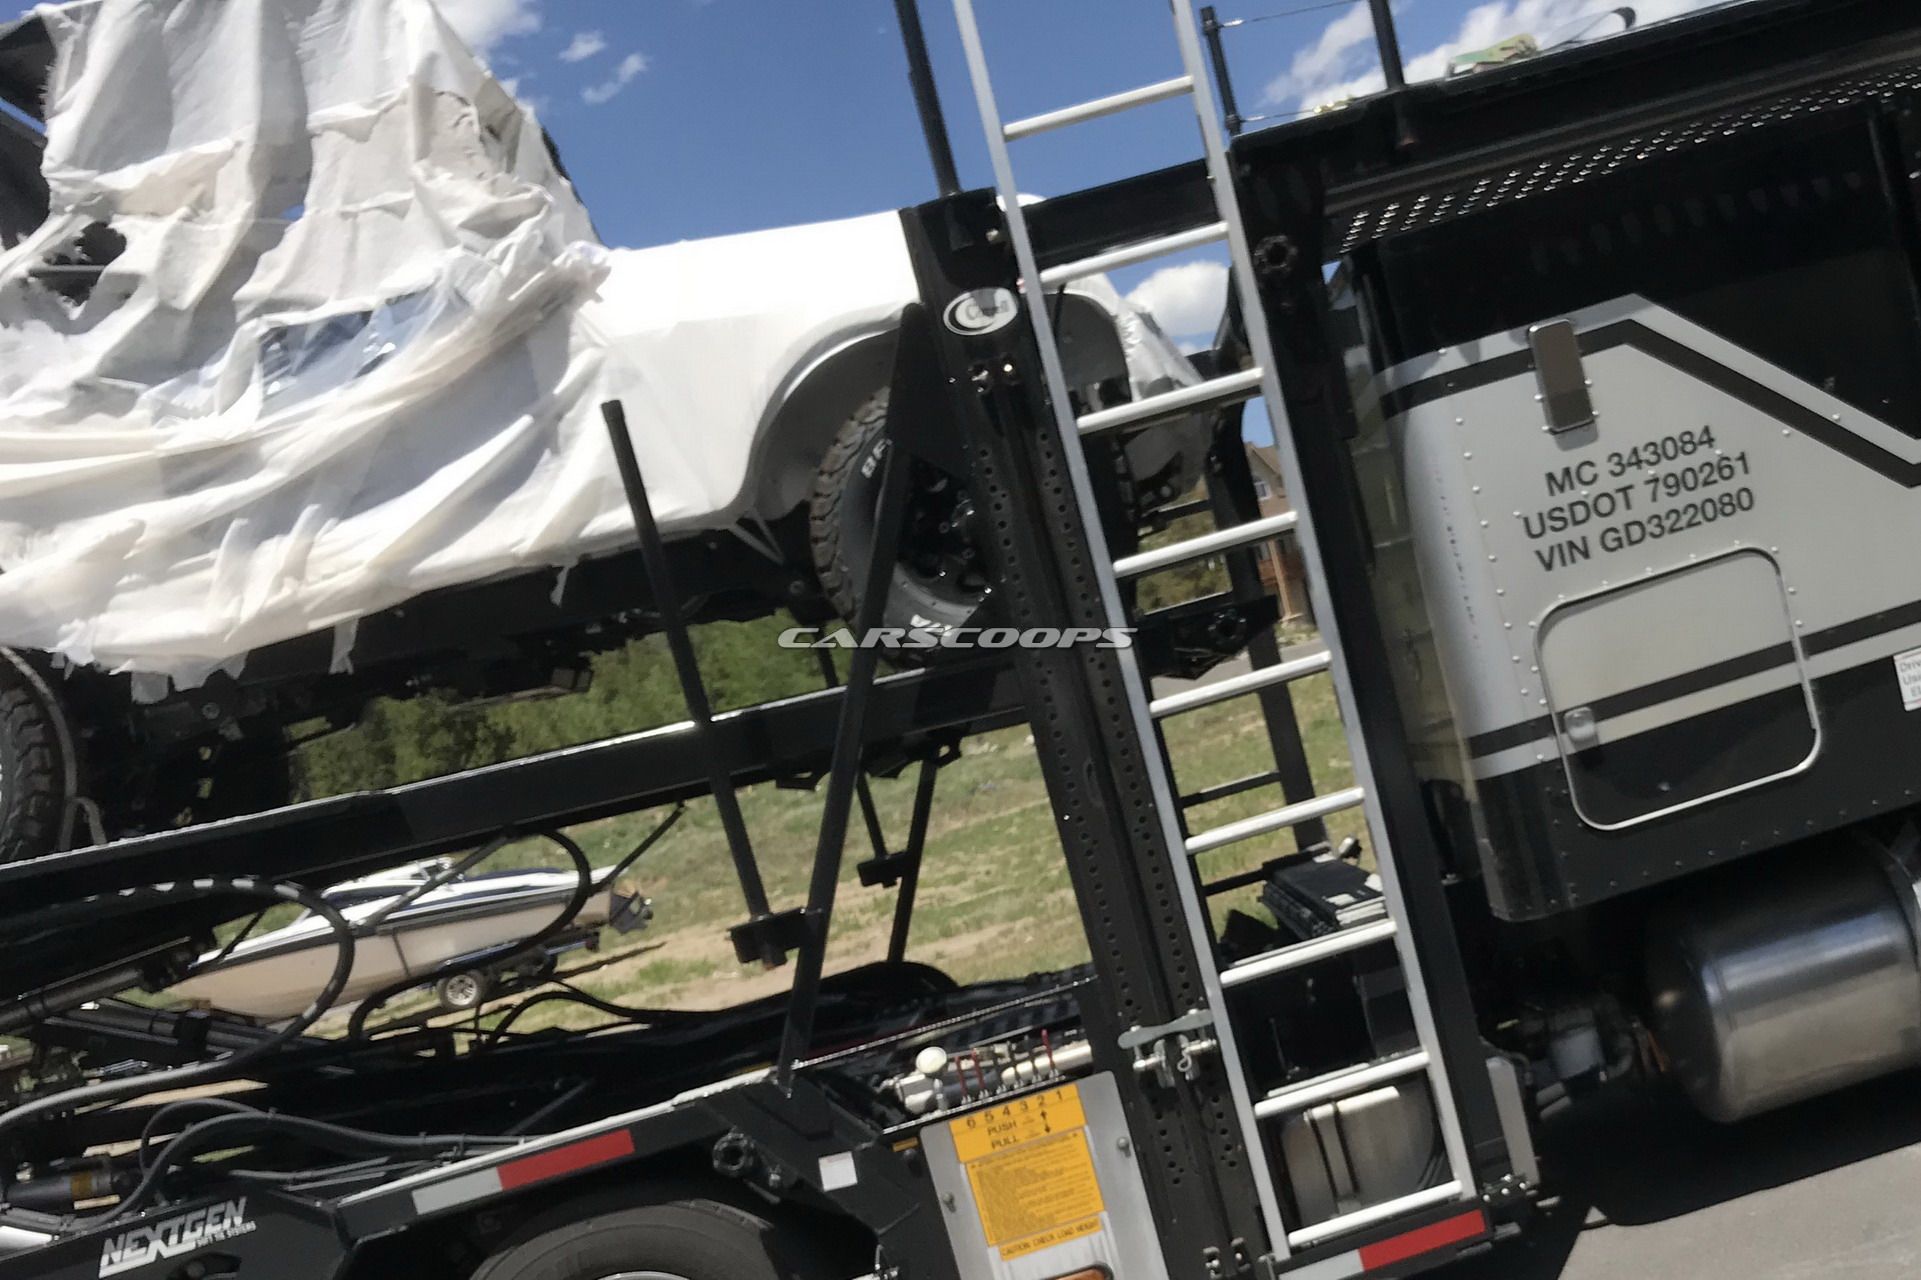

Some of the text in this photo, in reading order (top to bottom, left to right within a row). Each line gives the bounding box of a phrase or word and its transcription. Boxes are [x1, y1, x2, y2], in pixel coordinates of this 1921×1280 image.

[1523, 451, 1751, 539] USDOT 790261
[1545, 425, 1716, 497] MC 343084
[1534, 487, 1755, 572] VIN GD322080
[966, 1090, 1063, 1129] 6 5 4 3 2 1
[987, 1119, 1018, 1136] PUSH
[991, 1136, 1019, 1150] PULL
[98, 1196, 248, 1279] NEXTGEN
